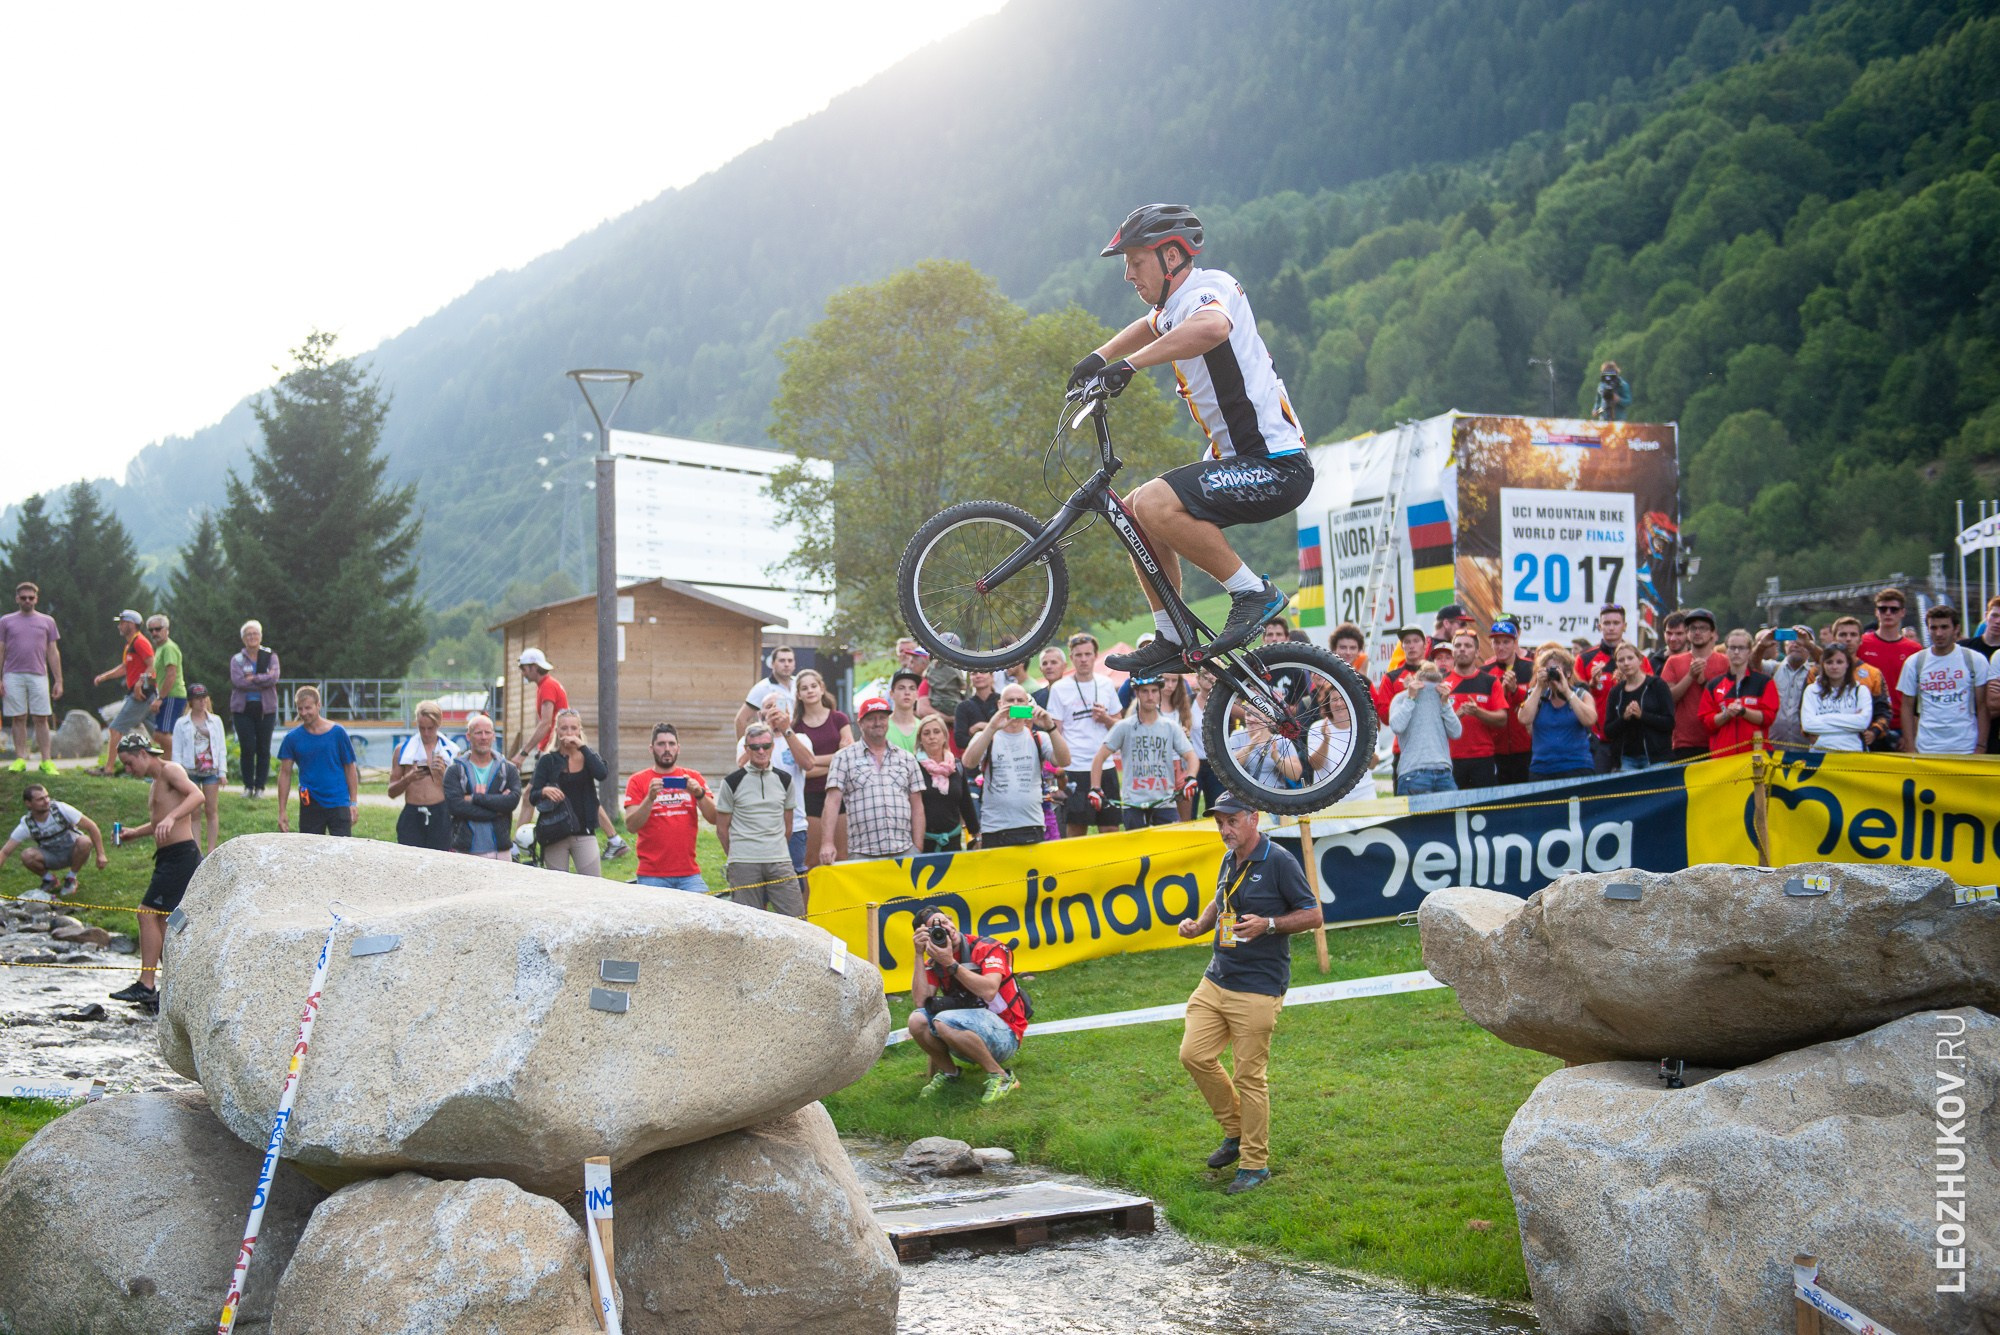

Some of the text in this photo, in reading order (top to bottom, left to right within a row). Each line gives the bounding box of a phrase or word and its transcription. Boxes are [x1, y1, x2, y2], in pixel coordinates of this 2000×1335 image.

[1512, 506, 1624, 523] UCI MOUNTAIN BIKE
[1513, 527, 1625, 543] WORLD CUP FINALS
[1513, 552, 1624, 604] 2017
[1559, 616, 1589, 632] 27TH
[1135, 735, 1168, 750] READY
[1132, 749, 1149, 762] FOR
[1744, 778, 2000, 864] Melin
[1313, 796, 1633, 904] Melinda
[878, 855, 1200, 971] Melinda
